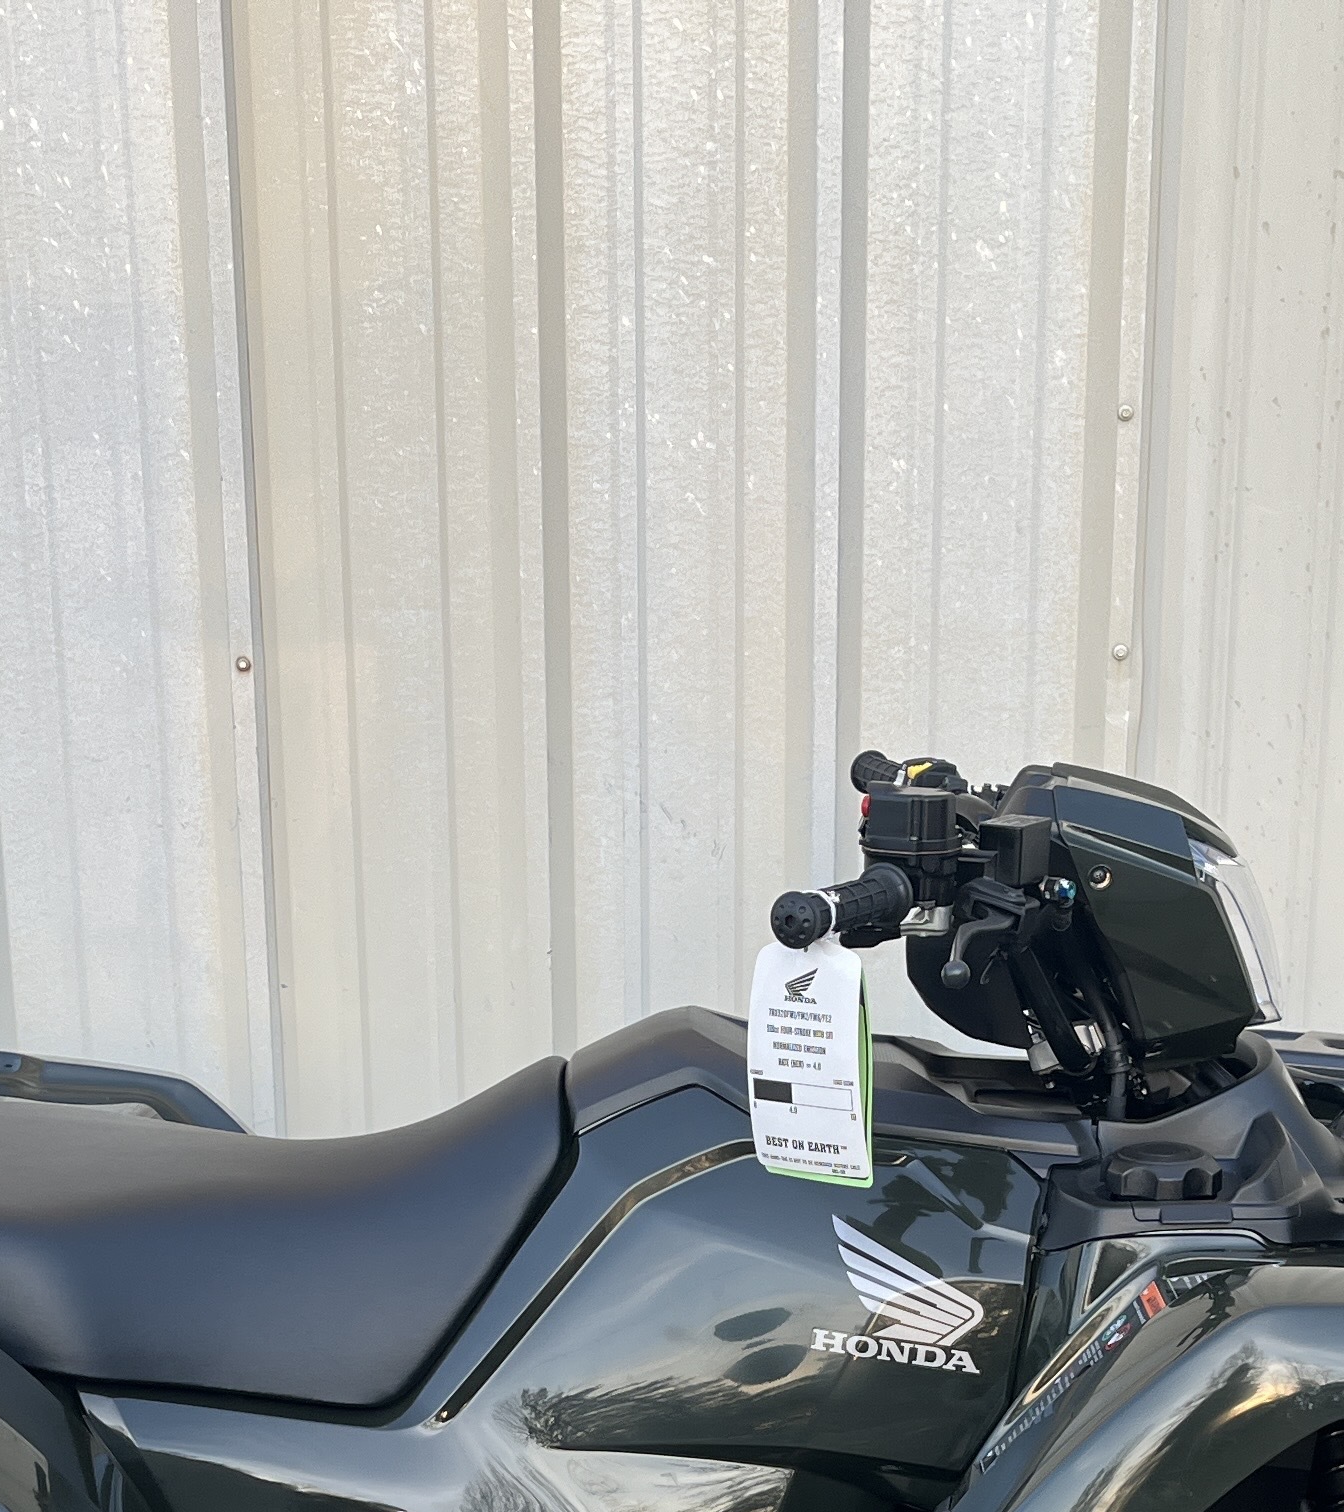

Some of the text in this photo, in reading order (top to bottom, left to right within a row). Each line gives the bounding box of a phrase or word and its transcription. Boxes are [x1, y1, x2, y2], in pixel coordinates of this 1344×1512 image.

[784, 995, 817, 1004] HONDA
[765, 1135, 789, 1149] BEST
[792, 1139, 805, 1151] ON
[810, 1328, 981, 1375] HONDA
